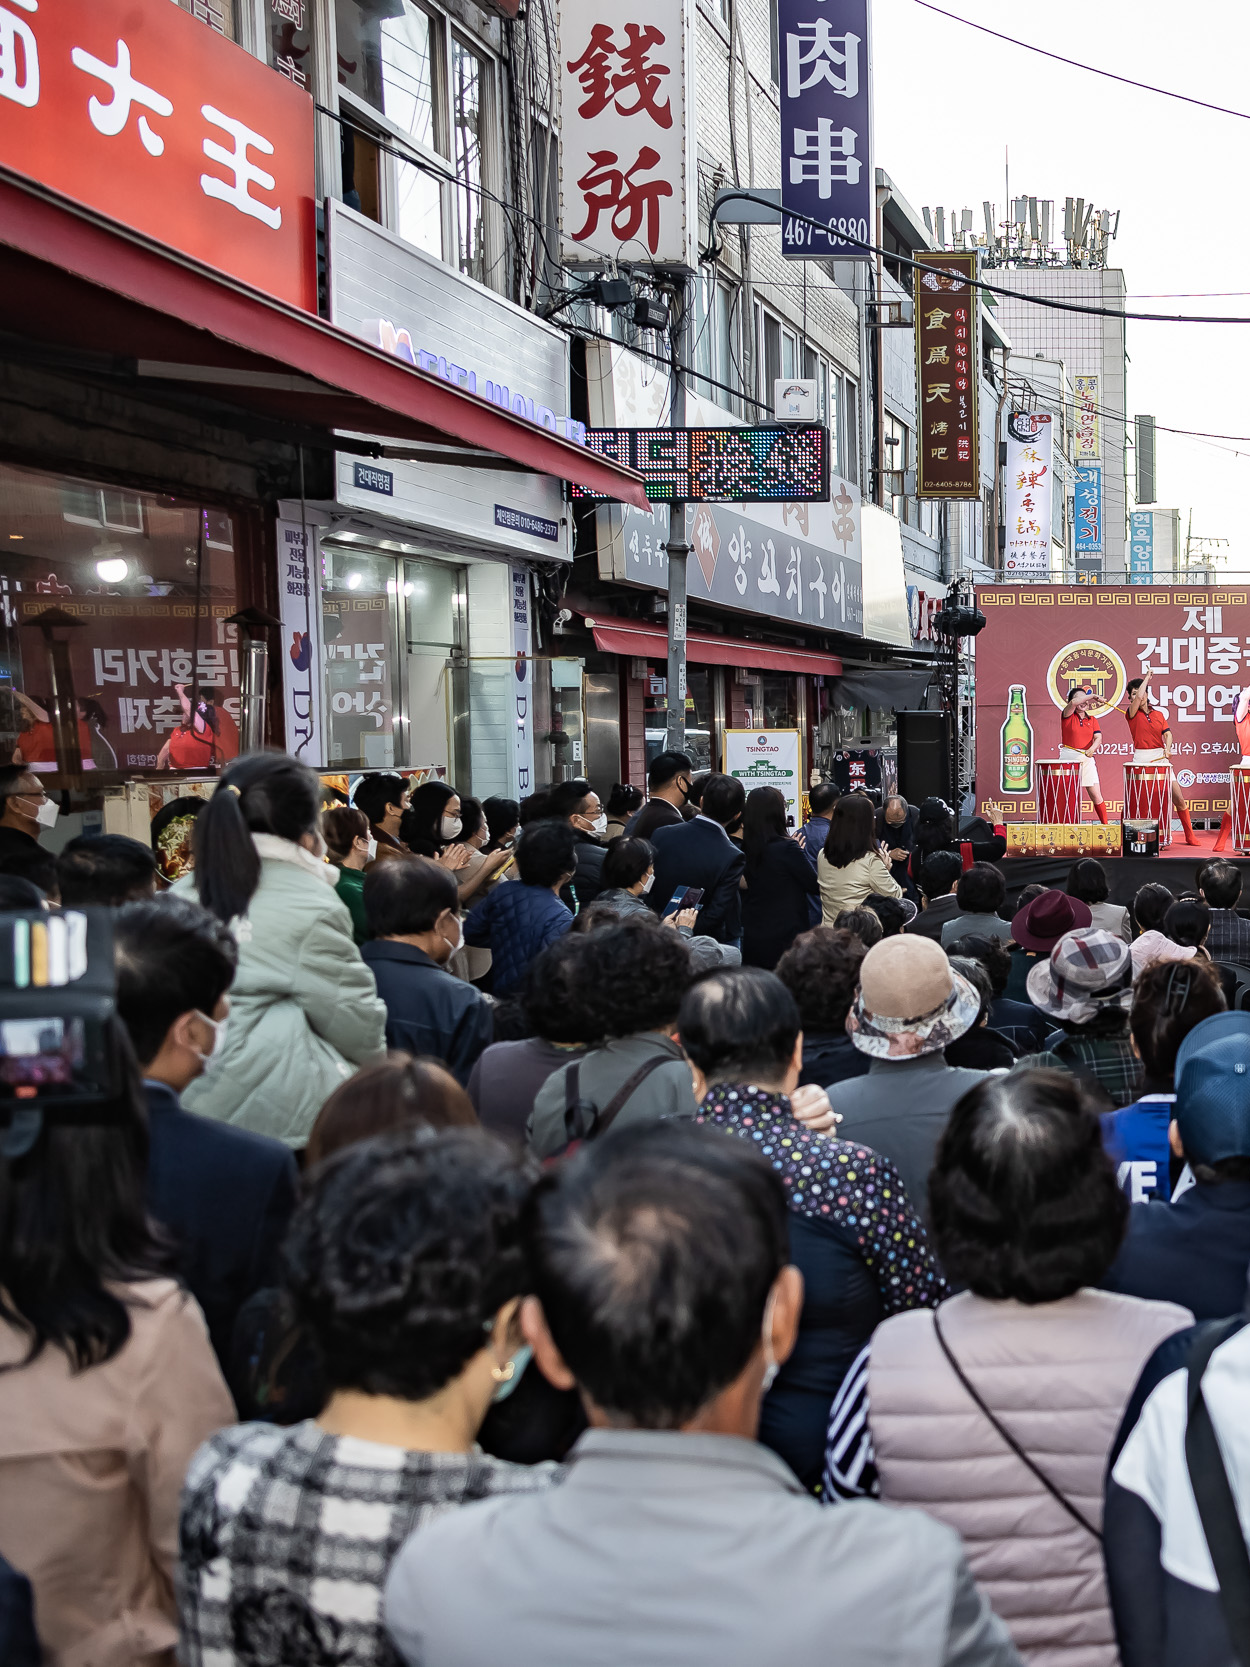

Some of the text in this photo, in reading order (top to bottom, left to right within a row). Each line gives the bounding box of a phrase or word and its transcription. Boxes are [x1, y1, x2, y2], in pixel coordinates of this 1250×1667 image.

[785, 215, 868, 247] 467-6880
[1076, 379, 1097, 391] 홍콩
[358, 467, 391, 491] 건대직영점
[924, 480, 973, 489] 02-6405-8786
[728, 525, 847, 623] 양꼬치구이
[1181, 606, 1223, 634] 제
